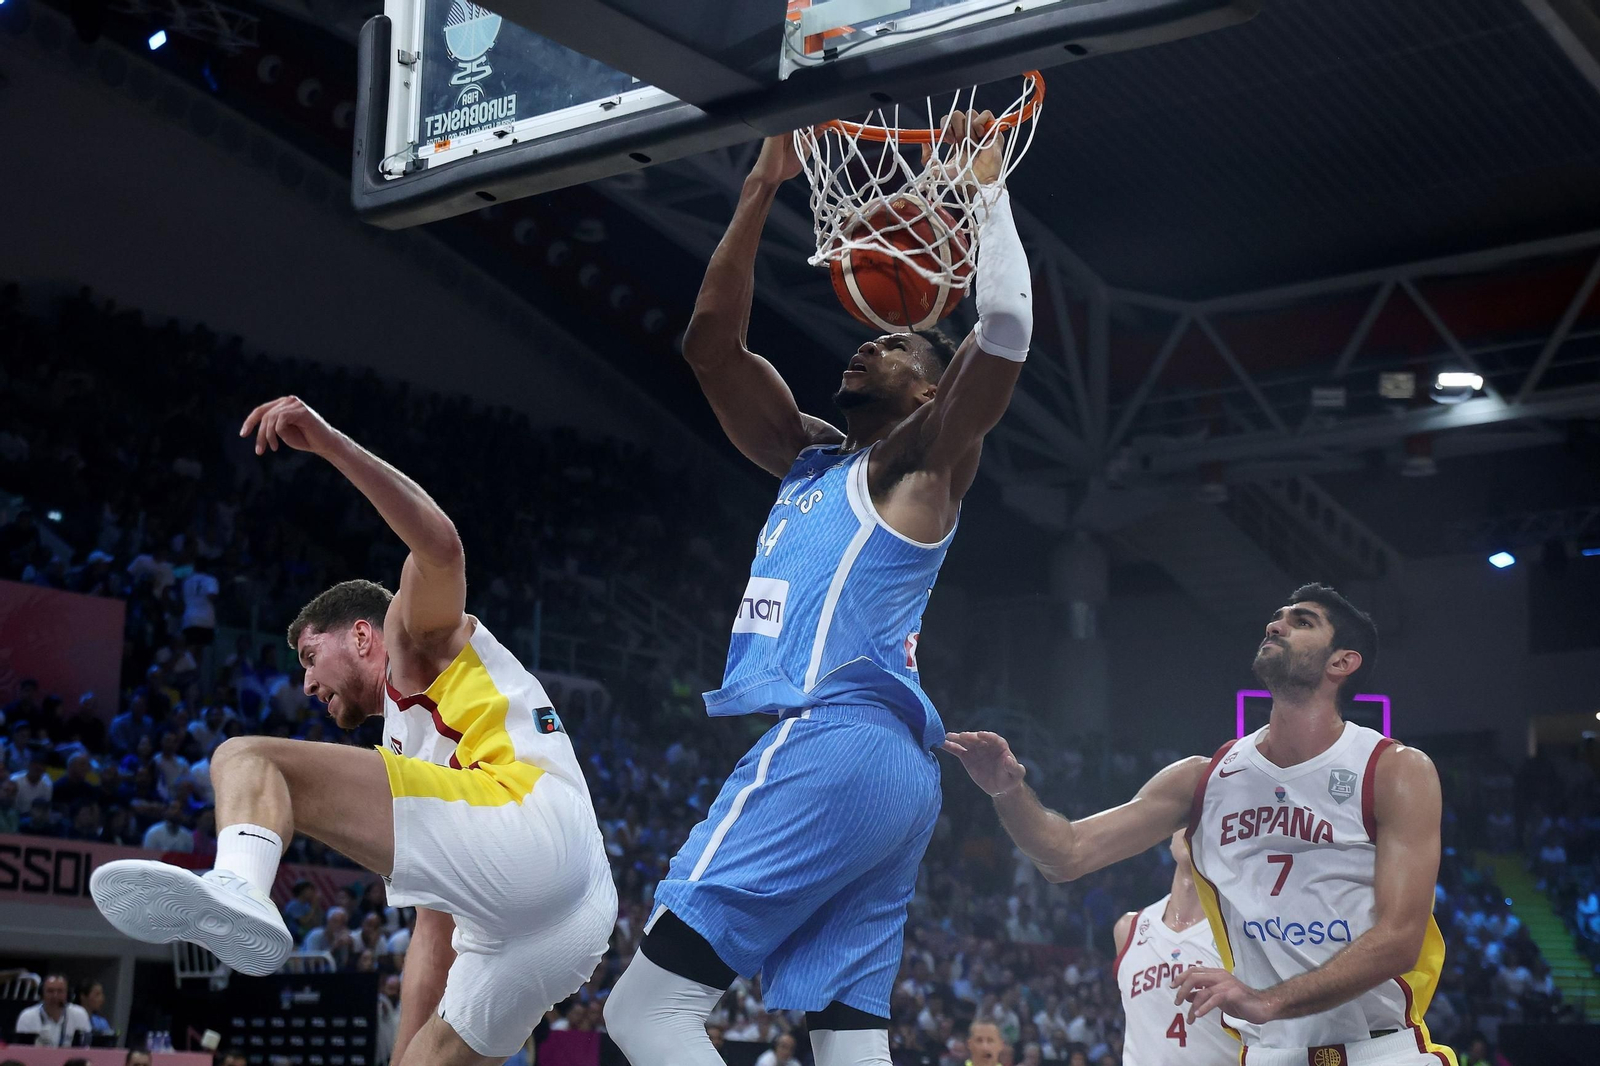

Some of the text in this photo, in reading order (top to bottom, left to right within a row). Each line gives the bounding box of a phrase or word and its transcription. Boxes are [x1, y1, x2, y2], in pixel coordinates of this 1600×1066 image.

[1220, 805, 1334, 847] ESPAÑA
[1267, 854, 1294, 896] 7
[1166, 1012, 1187, 1047] 4
